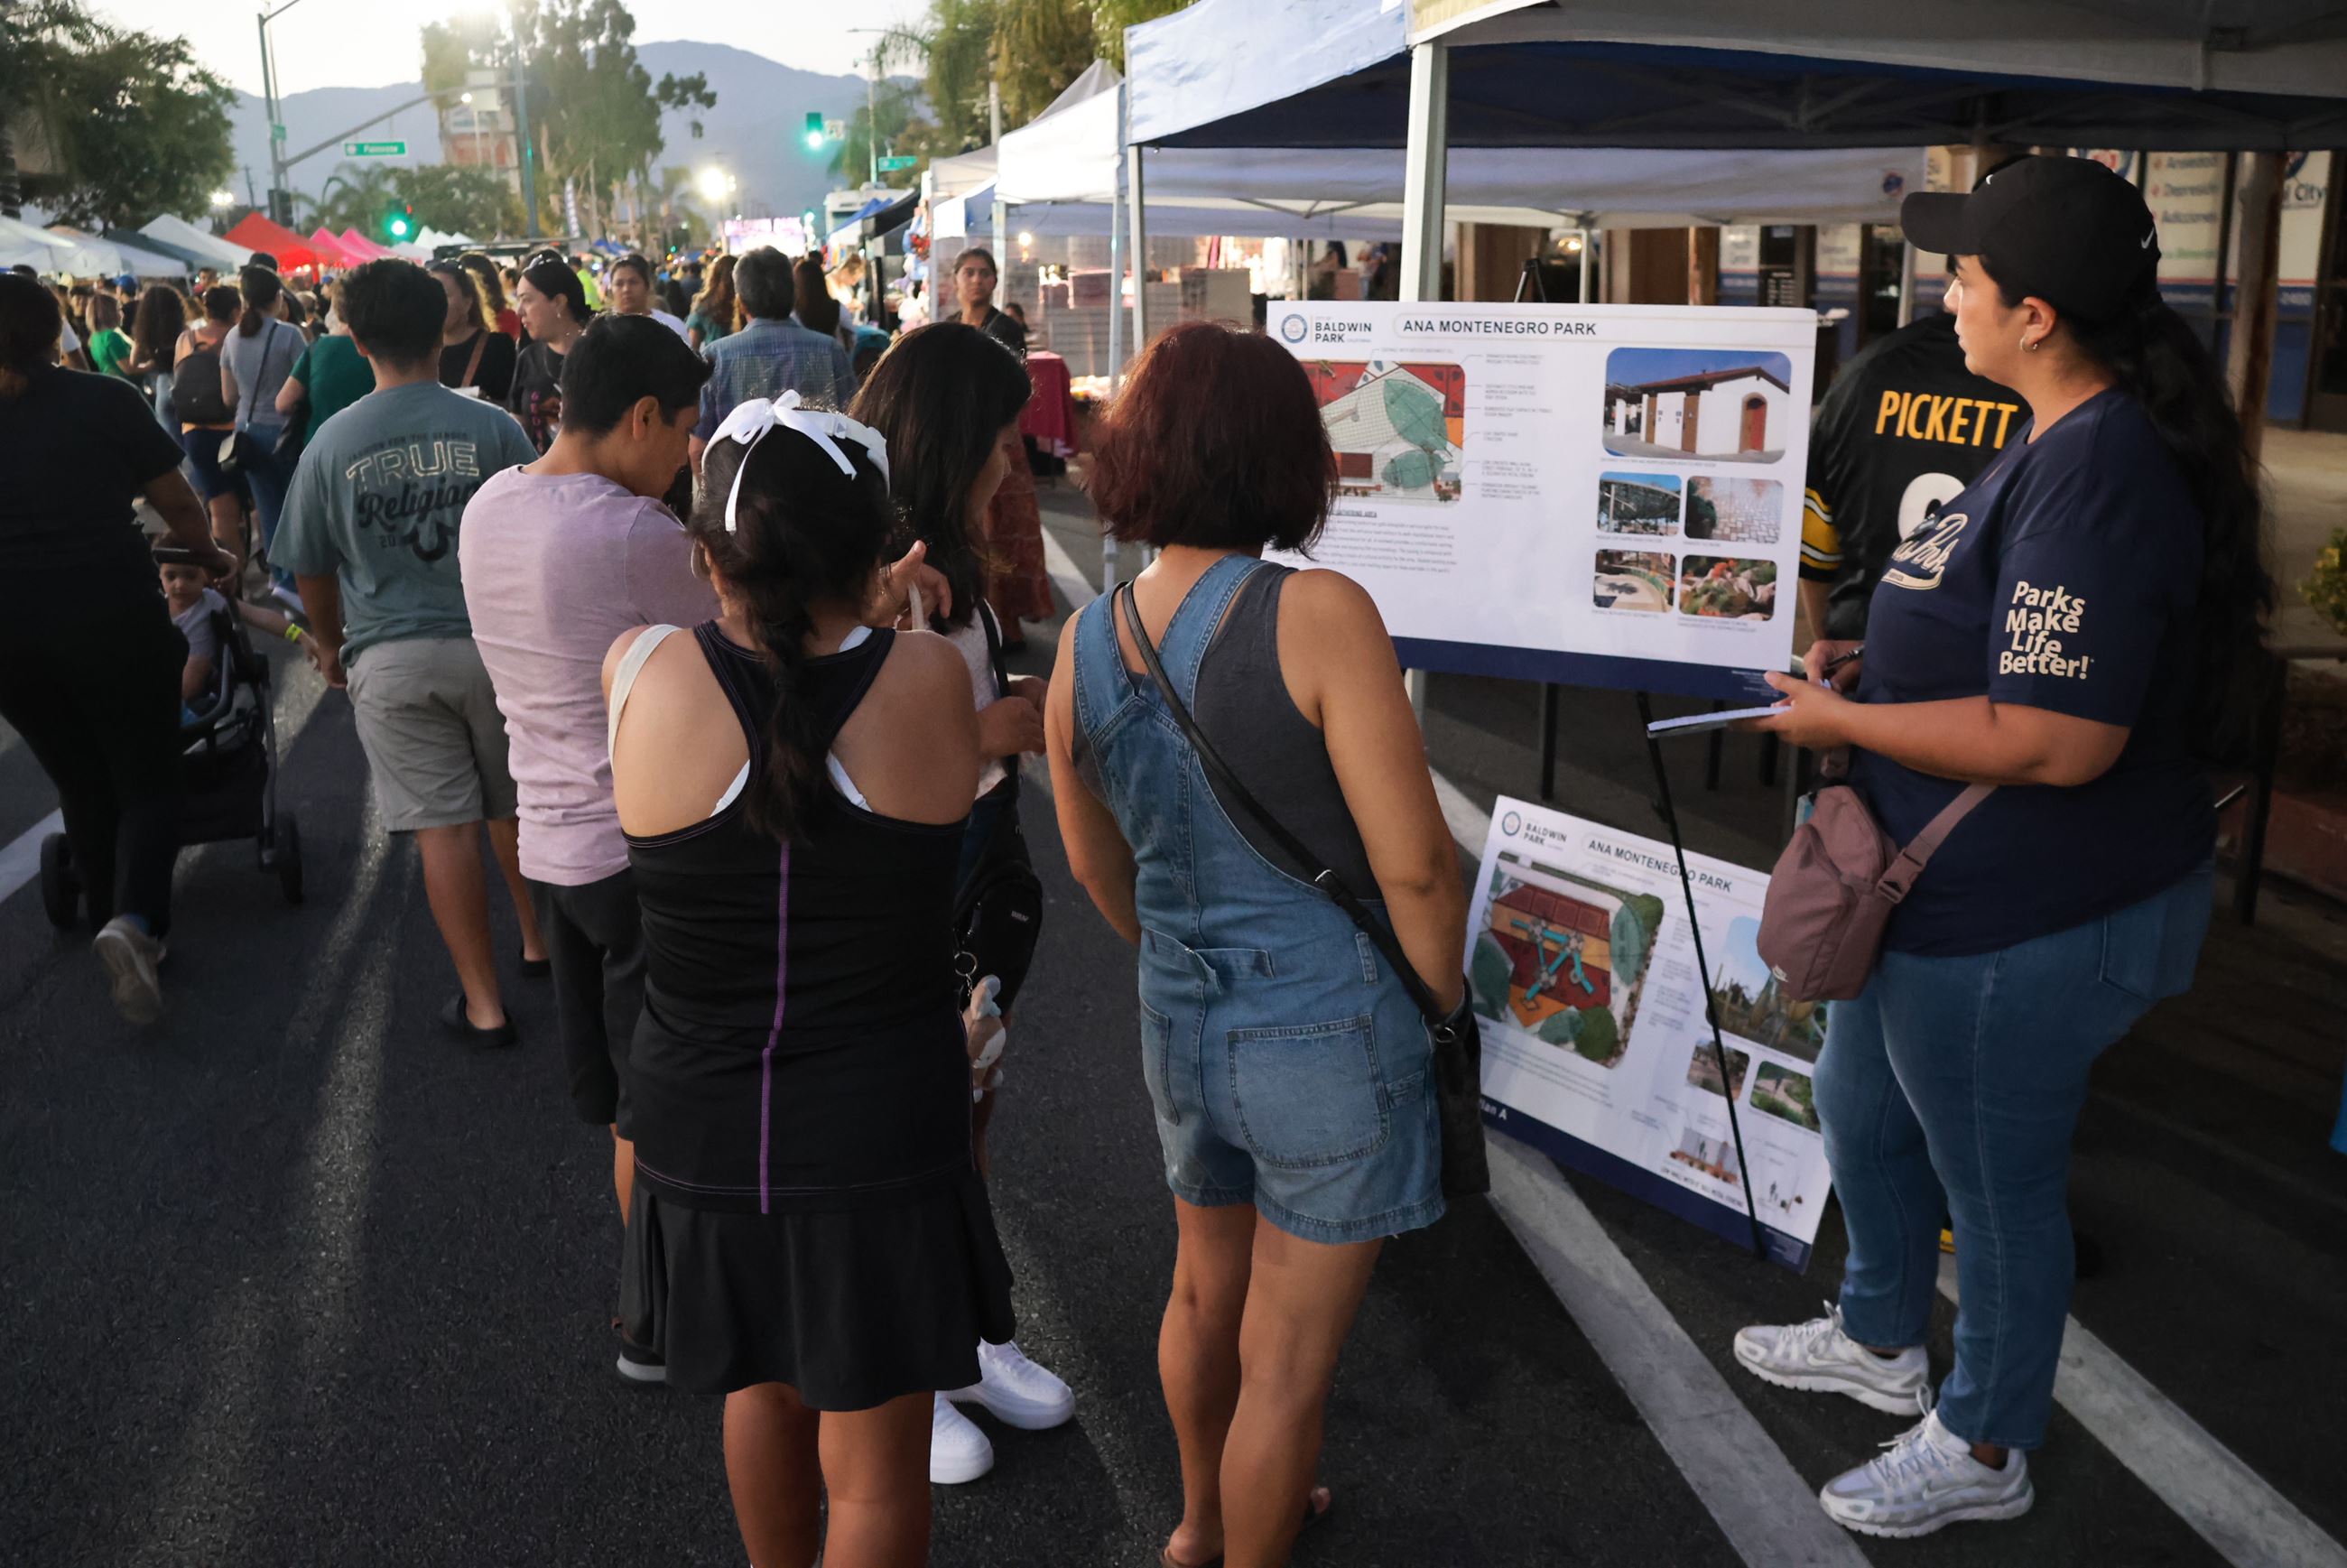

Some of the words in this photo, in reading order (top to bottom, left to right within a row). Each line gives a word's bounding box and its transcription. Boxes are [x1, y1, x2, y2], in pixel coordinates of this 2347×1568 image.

[2296, 182, 2326, 203] City
[1315, 322, 1372, 332] BALDWIN
[1315, 333, 1345, 343] PARK
[1403, 320, 1434, 332] ANA
[1439, 320, 1549, 335] MONTENEGRO
[1554, 322, 1596, 335] PARK
[1875, 390, 2019, 450] PICKETT
[345, 441, 480, 496] TRUE
[2011, 580, 2086, 617] Parks
[2005, 606, 2081, 634] Make
[2011, 629, 2063, 658] Life
[1999, 650, 2090, 680] Better!
[1524, 832, 1545, 846] PARK
[1526, 822, 1567, 842] BALDWIN
[1589, 840, 1611, 856] ANA
[1614, 848, 1696, 881] MONTENEGO
[1699, 873, 1732, 893] PARK
[1480, 1099, 1497, 1116] lan
[1498, 1109, 1507, 1120] A
